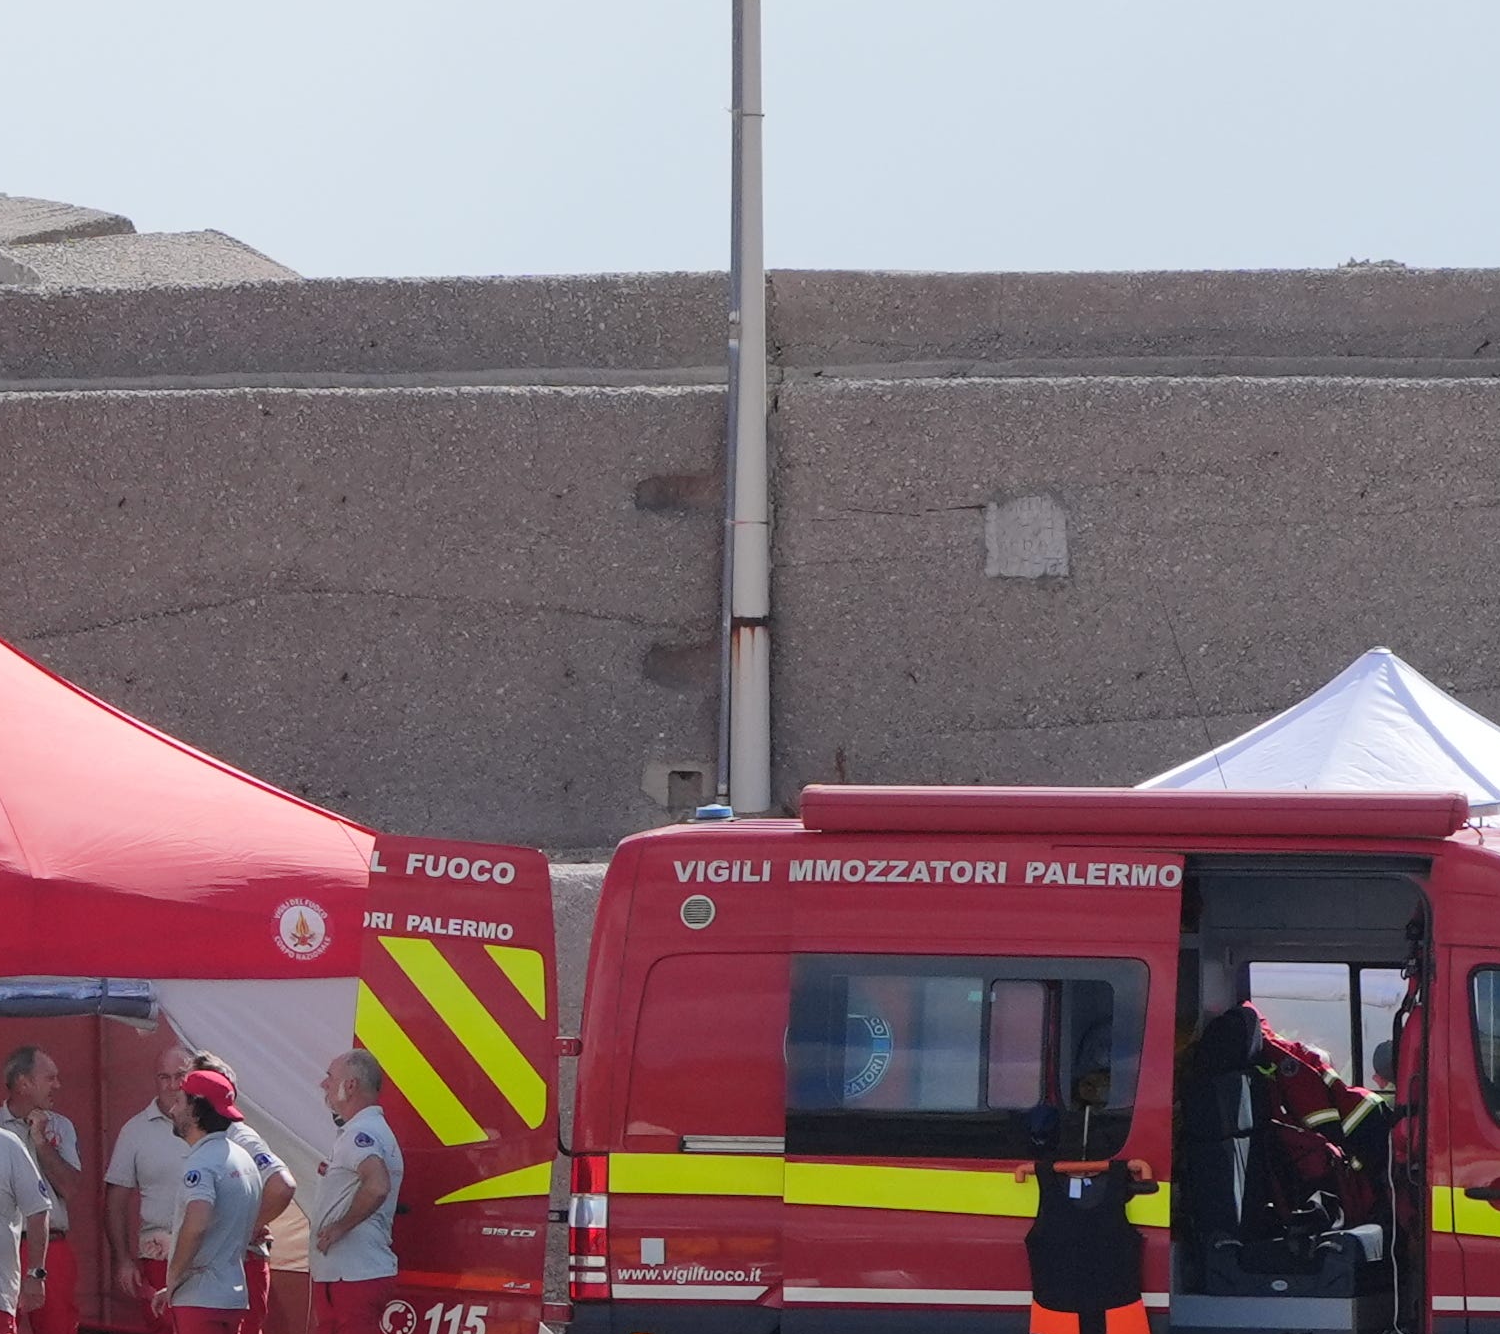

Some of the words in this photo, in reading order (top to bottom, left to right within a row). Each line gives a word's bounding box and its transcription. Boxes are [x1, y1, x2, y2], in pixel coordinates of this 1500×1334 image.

[405, 853, 516, 885] FUOCO
[673, 858, 772, 883] VIGILI
[787, 860, 1008, 885] MMOZZATORI
[1024, 860, 1184, 888] PALERMO
[406, 914, 514, 941] PALERMO
[617, 1266, 763, 1285] www.vigilfuoco.it
